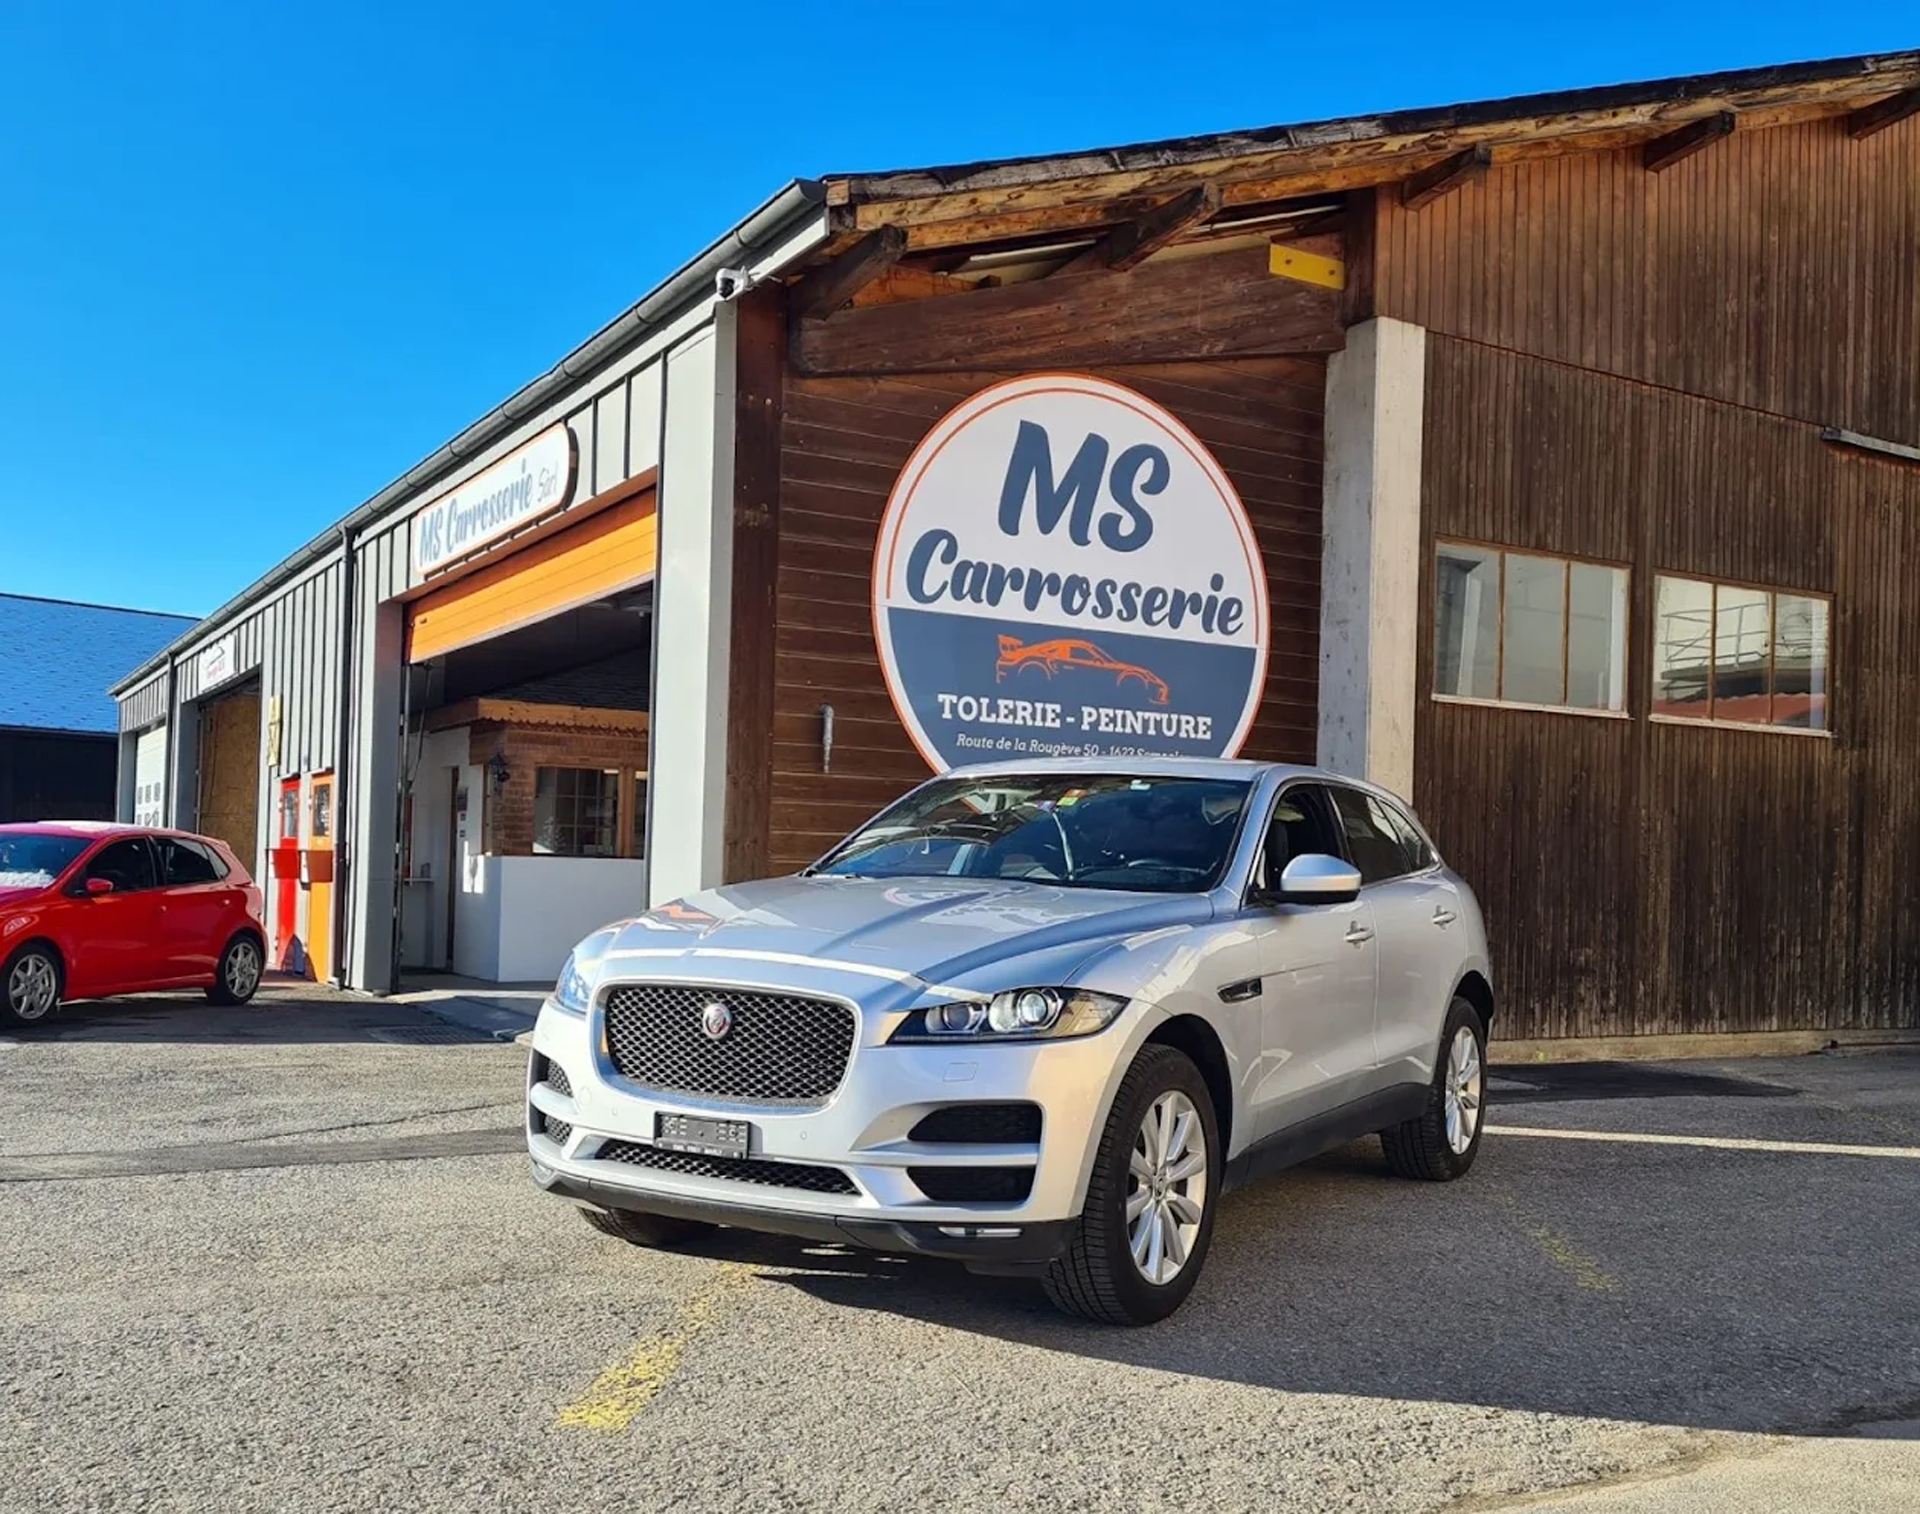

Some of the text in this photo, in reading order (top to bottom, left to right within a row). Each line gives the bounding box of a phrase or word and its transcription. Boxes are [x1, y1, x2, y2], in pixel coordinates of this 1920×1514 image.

[419, 507, 443, 566] MS
[446, 458, 532, 551] Carrosserie
[998, 420, 1171, 553] MS
[906, 528, 1244, 636] Carrosserie
[937, 693, 1061, 728] TOLERIE
[1081, 706, 1212, 740] PEINTURE
[956, 733, 994, 749] Route
[996, 737, 1012, 750] de
[1014, 738, 1027, 751] la
[1029, 739, 1081, 757] Rougève
[1083, 743, 1099, 757] 50
